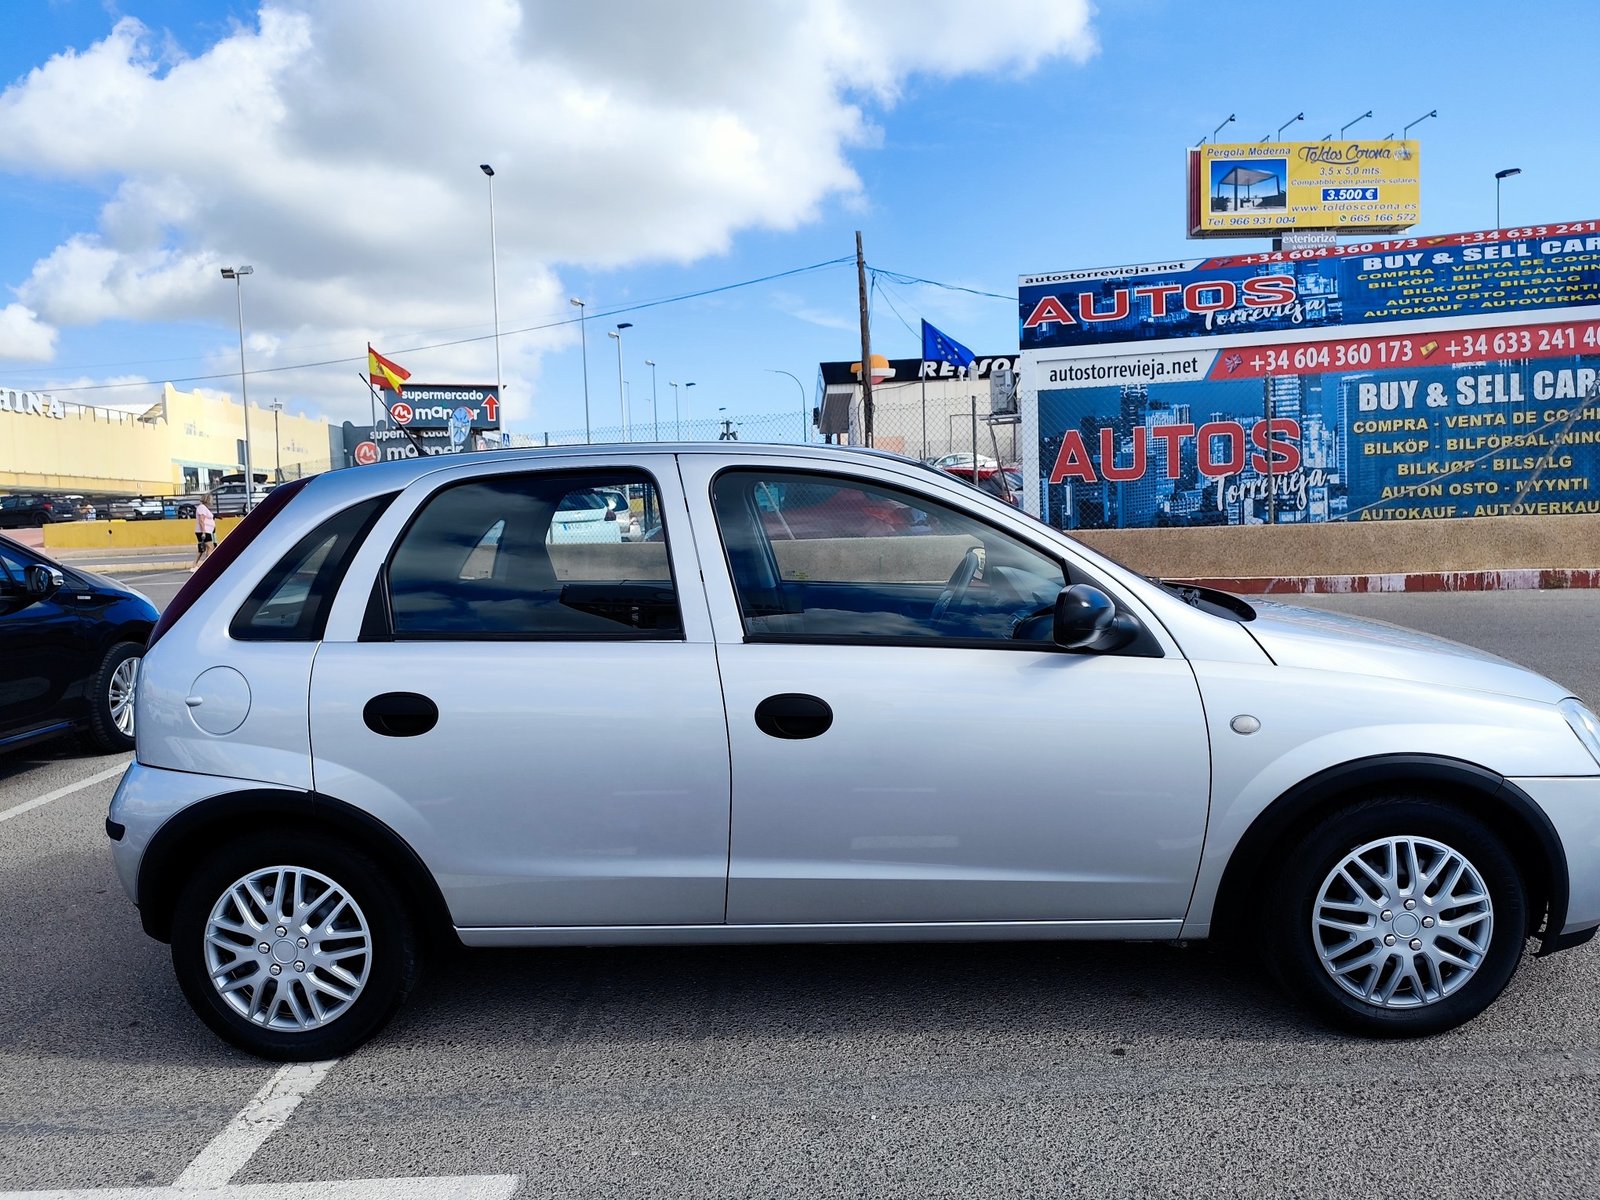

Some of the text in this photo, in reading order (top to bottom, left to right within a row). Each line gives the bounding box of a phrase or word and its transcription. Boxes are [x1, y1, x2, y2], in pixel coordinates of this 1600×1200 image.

[1207, 147, 1291, 158] Pergola Moderna
[1345, 144, 1391, 161] Corona
[1355, 178, 1386, 186] paneles
[1327, 189, 1375, 200] 3.500 €
[1229, 217, 1250, 225] 966
[1252, 217, 1271, 225] 931
[1350, 214, 1370, 222] 665
[1396, 213, 1417, 221] 572
[1282, 233, 1336, 243] exterioriza
[1454, 222, 1596, 243] +34 633 241
[1241, 252, 1284, 264] +34
[1289, 248, 1328, 259] 604
[1334, 243, 1373, 255] 360
[1380, 239, 1418, 250] 173
[1363, 253, 1424, 271] BUY
[1432, 252, 1454, 264] &
[1462, 244, 1532, 261] SELL
[1025, 262, 1186, 284] autostorrevieja.net
[1357, 268, 1434, 280] COMPRA
[1451, 261, 1513, 272] VENTA
[1500, 275, 1581, 287] BILSALG
[1368, 277, 1435, 289] BILKÖP
[1023, 275, 1297, 328] AUTOS
[1364, 304, 1462, 317] AUTOKAUF
[1480, 293, 1600, 308] AUTOVERKA
[1386, 295, 1448, 306] AUTON
[1455, 291, 1505, 300] OSTO
[1523, 283, 1598, 295] MYYNTI
[1199, 299, 1326, 330] Torrevieja
[1445, 334, 1488, 357] +34
[1493, 331, 1531, 354] 633
[1538, 328, 1575, 351] 241
[1250, 340, 1413, 371] +34 604 360 173
[1049, 357, 1198, 382] autostorrevieja.net
[401, 390, 483, 402] supermercado
[1359, 368, 1600, 411] BUY & SELL CAR
[1353, 418, 1428, 433] COMPRA
[1445, 413, 1506, 428] VENTA
[1513, 411, 1536, 424] DE
[1049, 418, 1301, 484] AUTOS
[1364, 439, 1429, 455] BILKÖP
[1209, 467, 1330, 512] Torrevieja
[1381, 484, 1442, 498] AUTON
[1449, 481, 1498, 495] OSTO
[1361, 506, 1456, 520] AUTOKAUF
